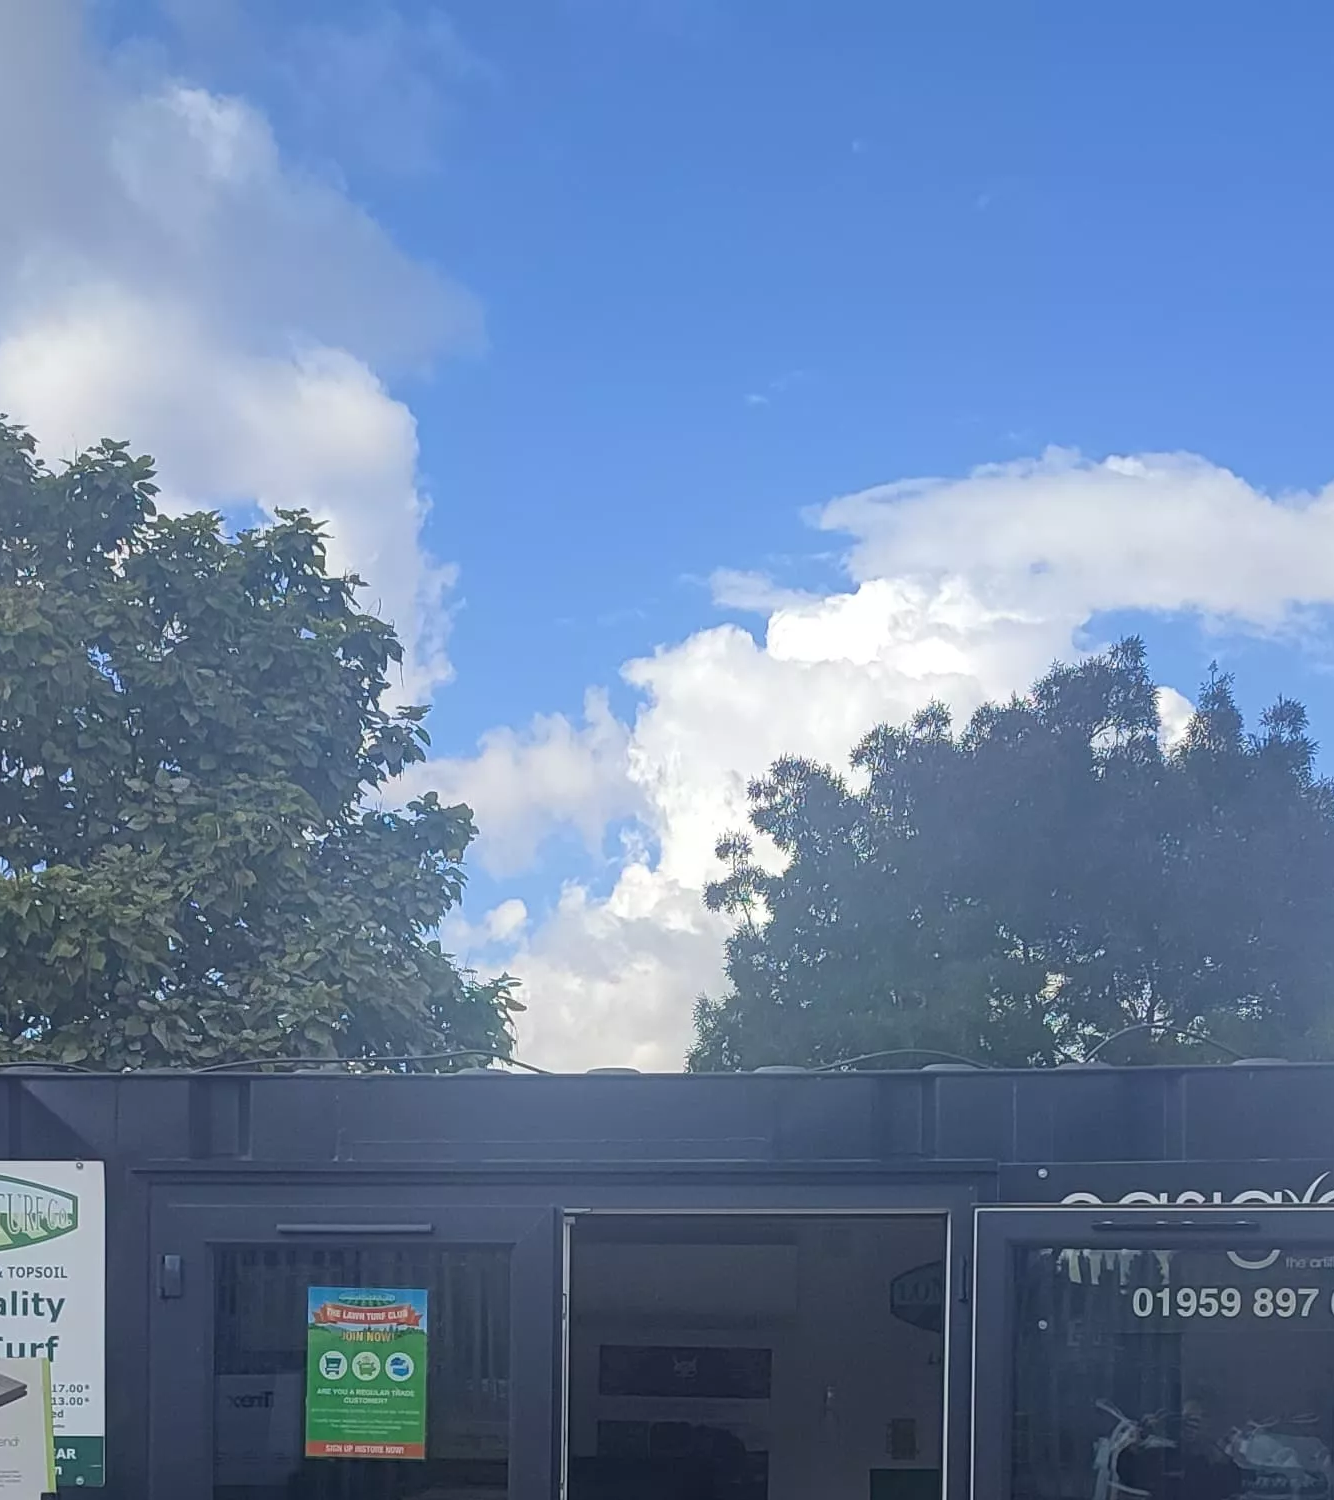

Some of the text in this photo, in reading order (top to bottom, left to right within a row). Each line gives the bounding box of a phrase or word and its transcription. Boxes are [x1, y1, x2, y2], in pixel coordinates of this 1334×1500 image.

[7, 1265, 68, 1279] TOPSOIL
[1132, 1287, 1241, 1318] 01959
[1253, 1287, 1320, 1318] 897
[327, 1308, 408, 1321] THE LAWN TURF CLUB
[341, 1332, 395, 1342] JOIN NOW!
[392, 1389, 415, 1397] TRADE
[326, 1445, 342, 1453] SIGN
[344, 1445, 354, 1453] UP
